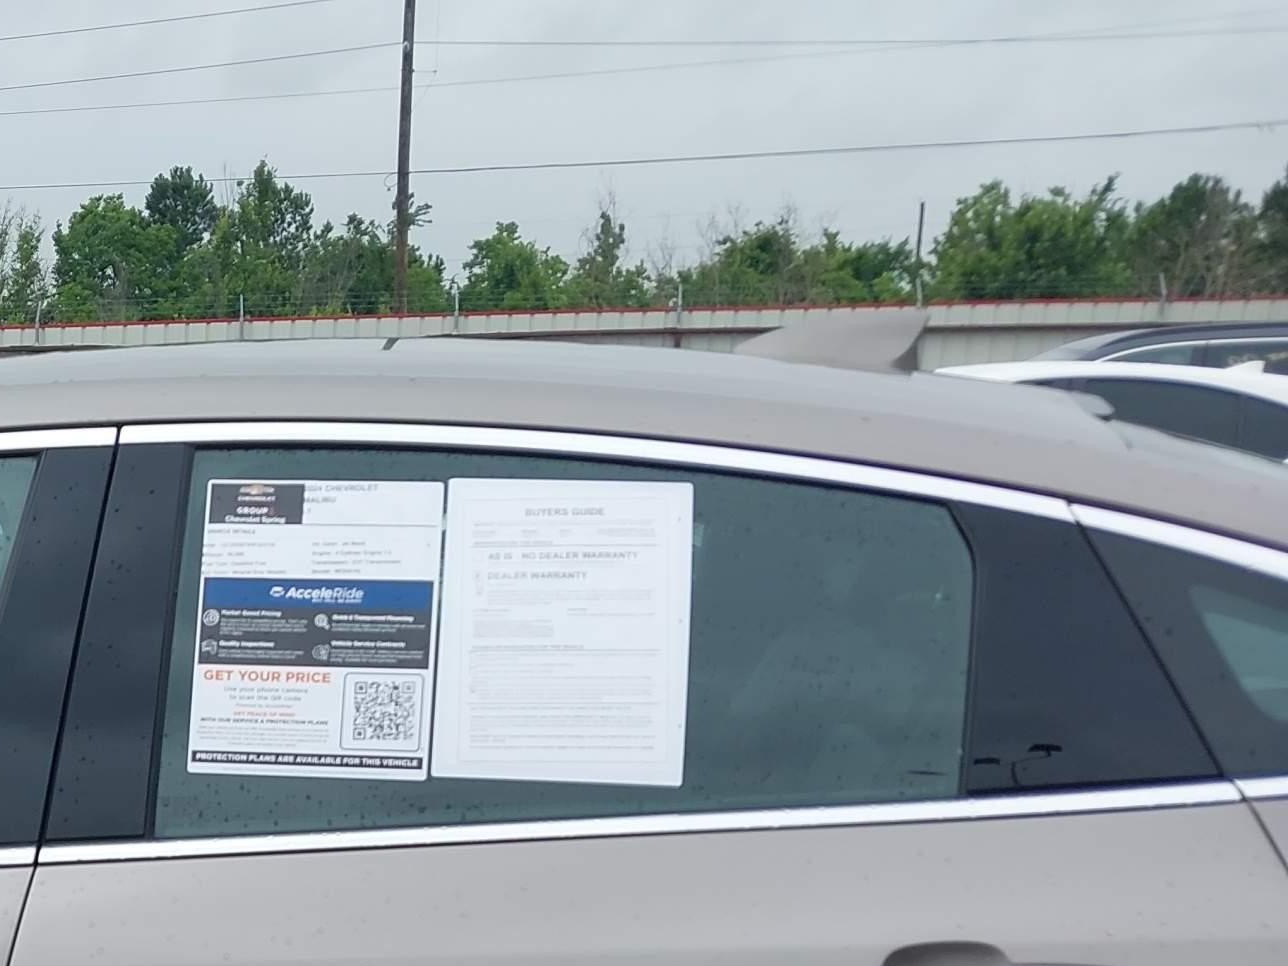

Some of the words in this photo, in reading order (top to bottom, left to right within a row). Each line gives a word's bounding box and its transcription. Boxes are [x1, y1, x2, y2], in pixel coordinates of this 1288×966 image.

[236, 506, 269, 514] GROUP
[524, 507, 569, 516] BUYERS
[571, 507, 606, 516] GUIDE
[539, 552, 579, 560] DEALER
[581, 551, 638, 559] WARRANTY
[488, 571, 528, 579] DEALER
[530, 571, 588, 579] WARRANTY
[285, 586, 364, 601] AcceleRide
[204, 669, 234, 681] GET
[239, 670, 281, 682] YOUR
[286, 671, 332, 684] PRICE
[257, 686, 280, 695] phone
[196, 752, 248, 761] PROTECTION
[248, 754, 277, 763] PLANS
[277, 755, 295, 763] ARE
[295, 756, 342, 765] AVAILABLE
[343, 758, 361, 766] FOR
[362, 758, 382, 767] THIS
[382, 759, 420, 768] VEHICLE
